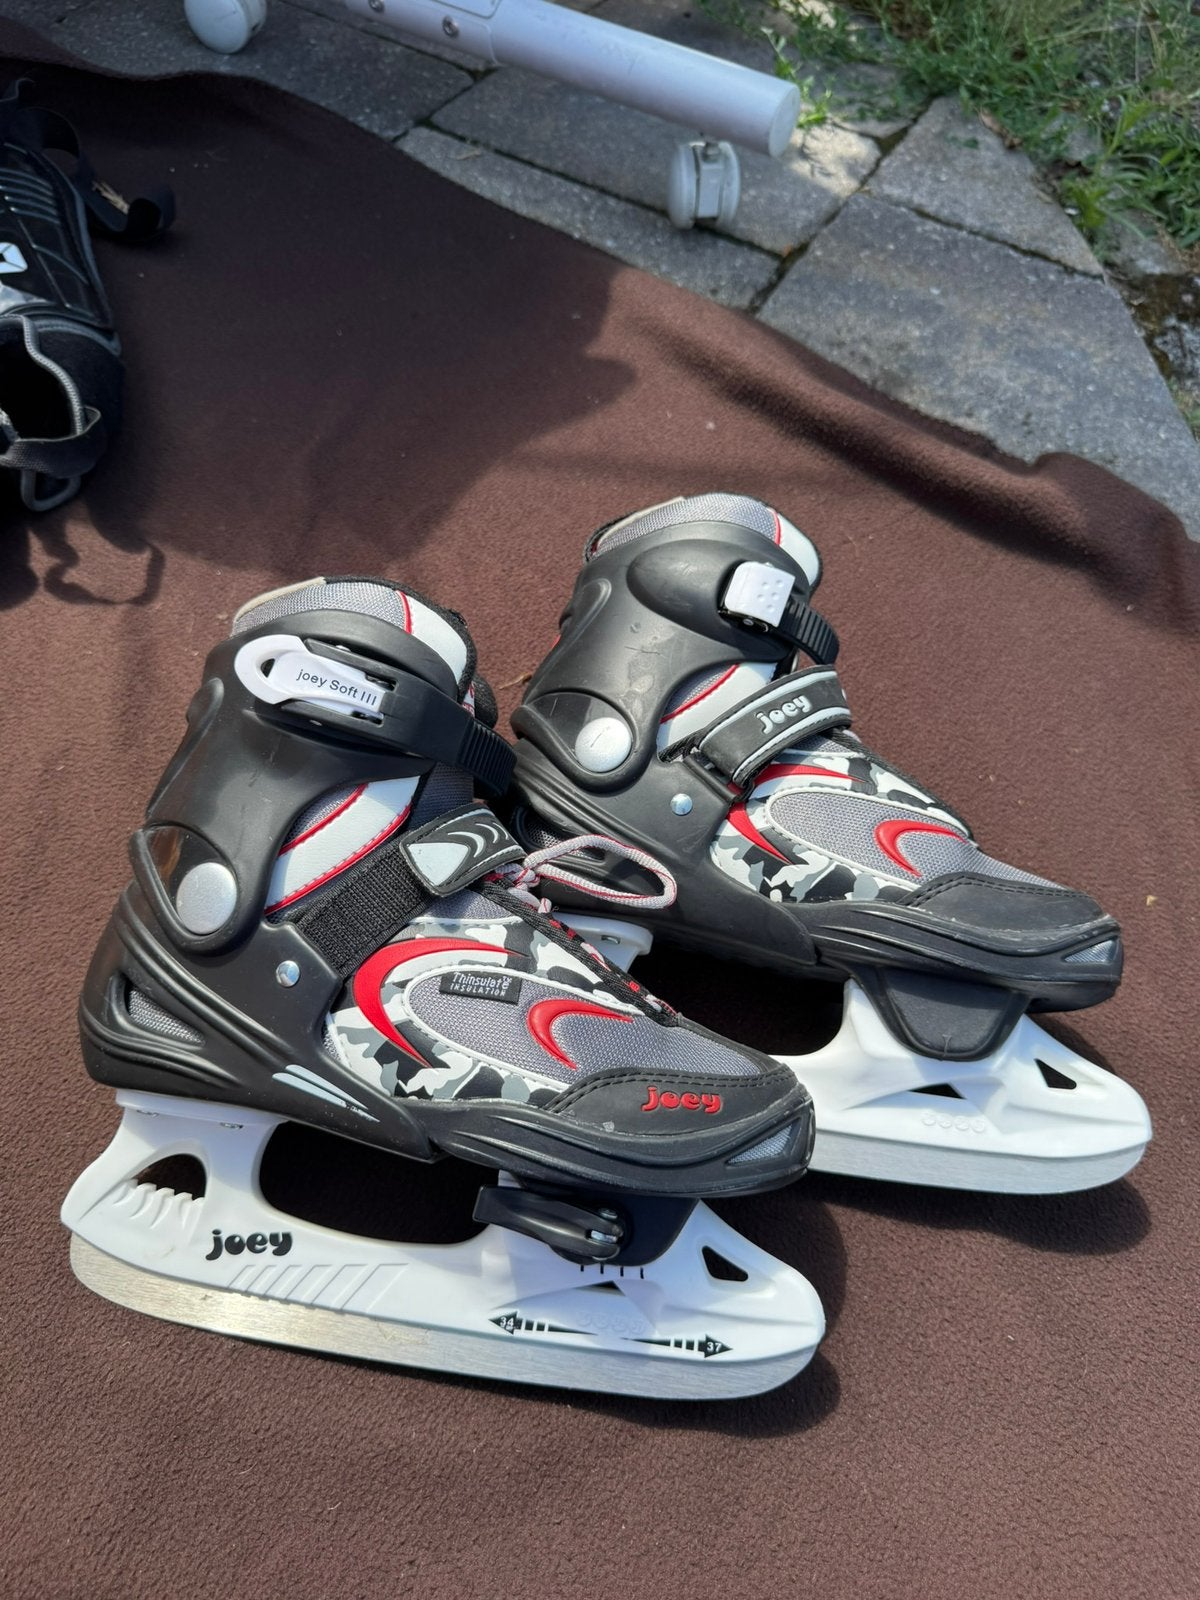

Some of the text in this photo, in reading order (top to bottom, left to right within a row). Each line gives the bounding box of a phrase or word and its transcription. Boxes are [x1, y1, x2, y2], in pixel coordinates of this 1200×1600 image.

[296, 669, 327, 687] joey
[329, 680, 359, 698] Soft
[756, 695, 811, 734] joey
[450, 983, 506, 996] INSULATION
[641, 1085, 722, 1114] joey
[205, 1229, 292, 1261] joey
[500, 1316, 514, 1330] 34
[706, 1341, 722, 1352] 37
